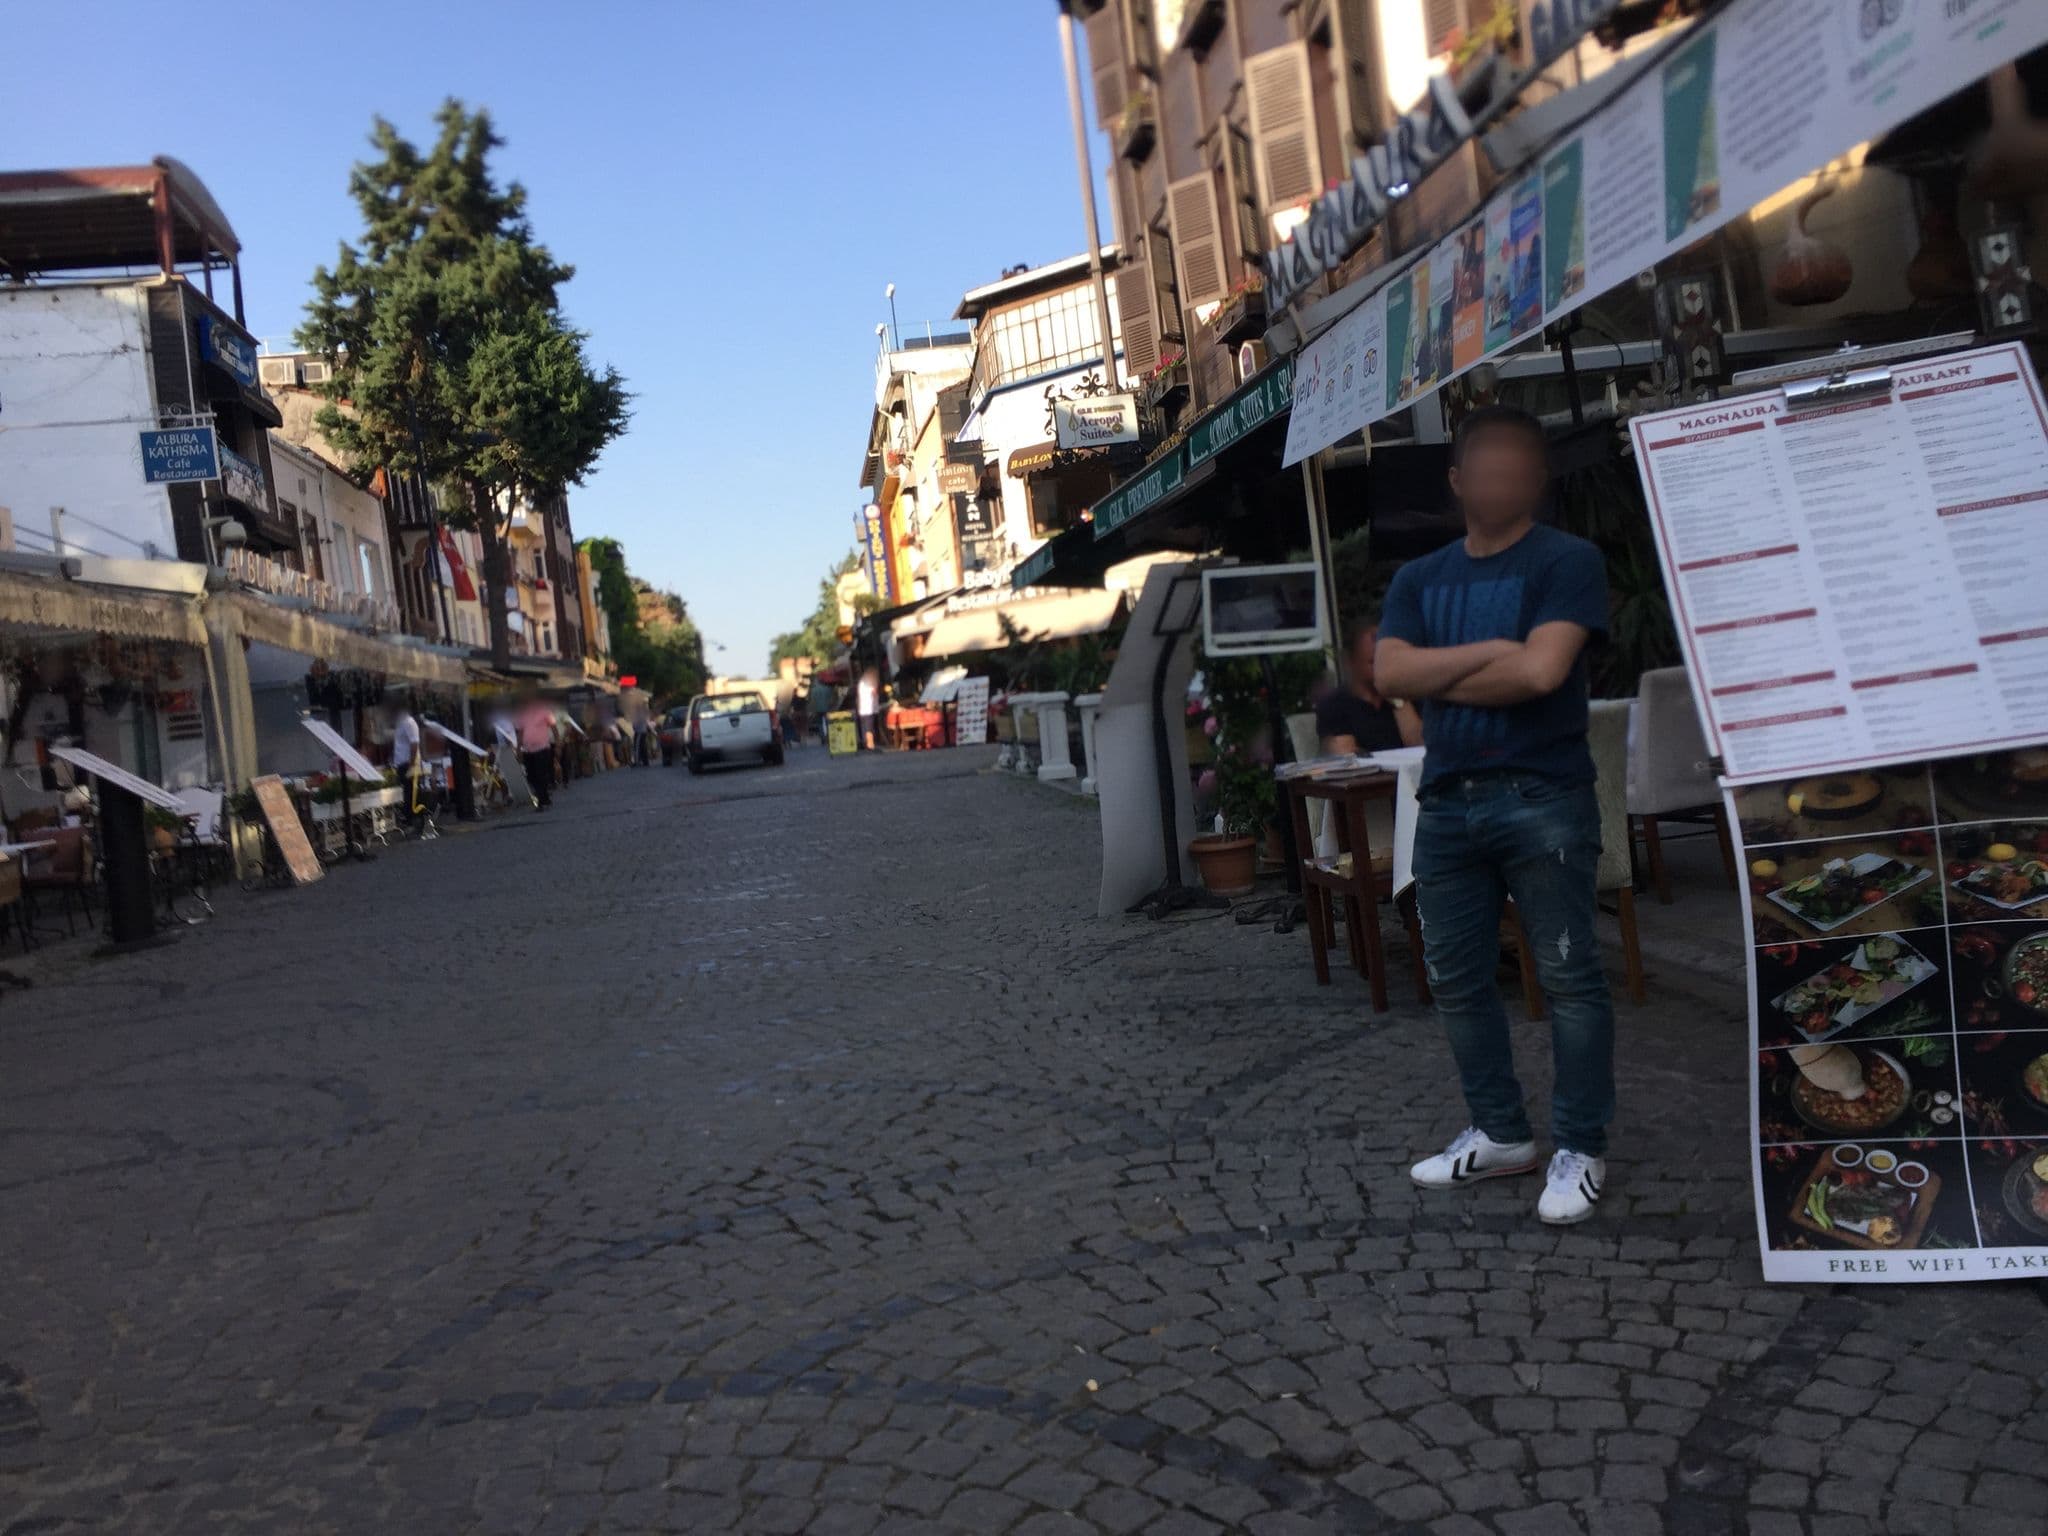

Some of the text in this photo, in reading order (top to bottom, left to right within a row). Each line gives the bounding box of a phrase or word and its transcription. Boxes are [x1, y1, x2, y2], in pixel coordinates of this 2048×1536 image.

[1264, 75, 1474, 319] MAGNAURA
[1679, 365, 1972, 431] MAGNAURA AURANT
[1239, 386, 1265, 432] SUITES
[1079, 412, 1123, 428] Acropol
[155, 432, 199, 447] ALBURA
[1079, 428, 1114, 440] Suites
[148, 444, 208, 459] KATHISMA
[153, 468, 209, 480] Restaurant
[1127, 469, 1164, 516] PREMIER
[1829, 1258, 1888, 1273] FREE
[1907, 1257, 1966, 1272] WIFI
